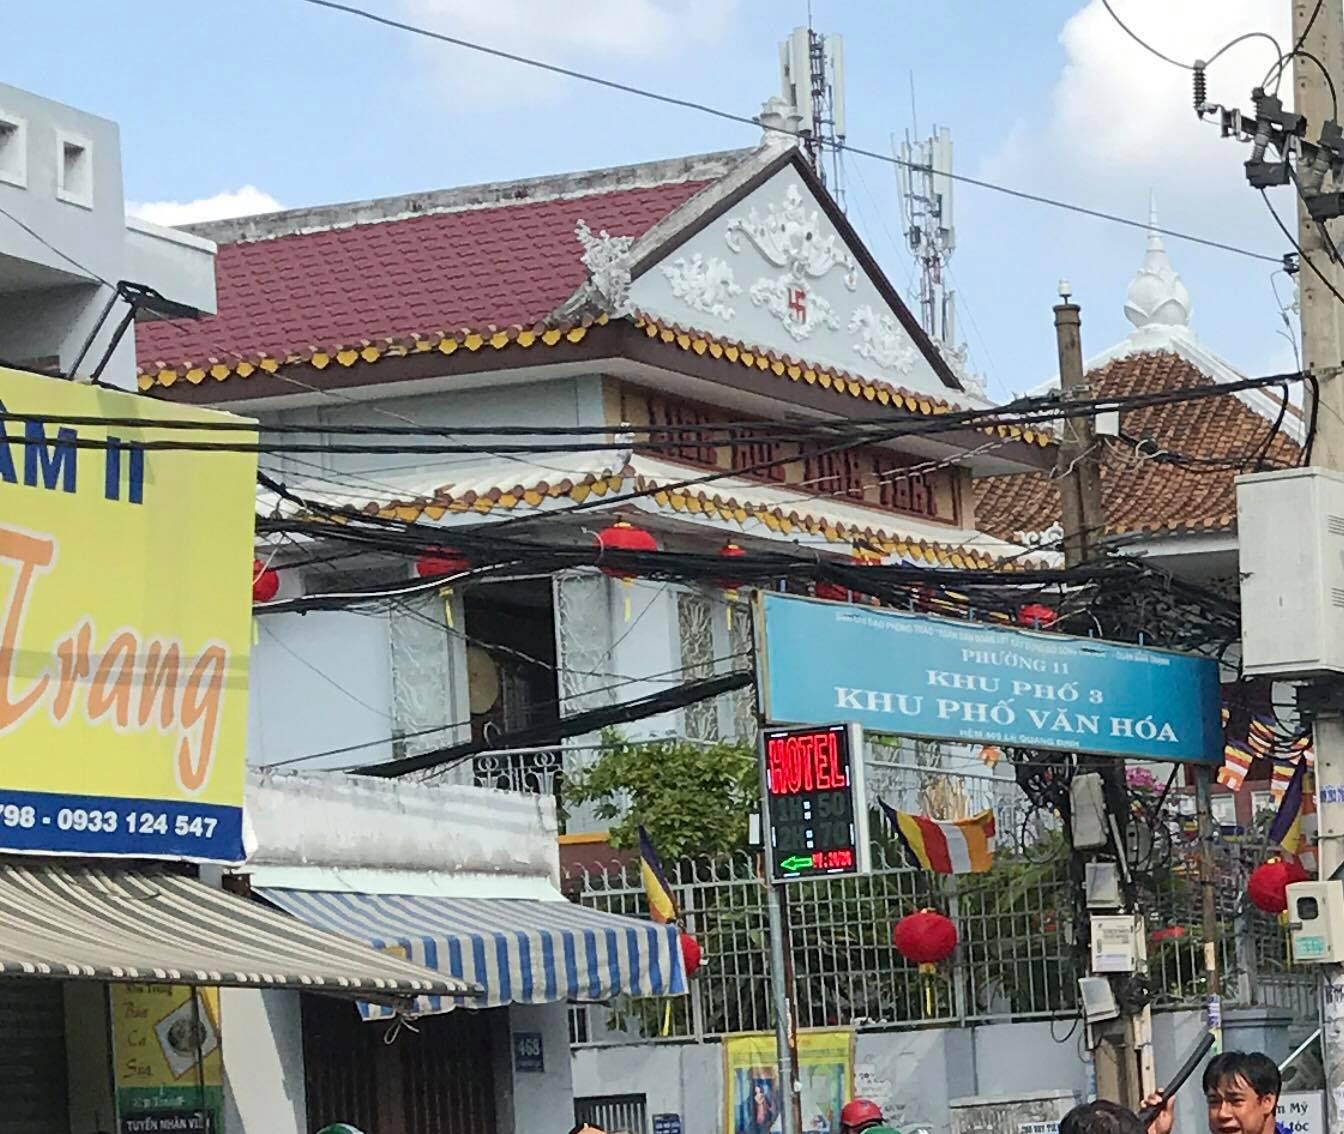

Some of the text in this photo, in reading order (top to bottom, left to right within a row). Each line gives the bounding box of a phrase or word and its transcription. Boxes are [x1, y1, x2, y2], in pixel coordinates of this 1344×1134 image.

[962, 648, 1069, 675] PHƯỜNG 11
[927, 669, 1104, 704] KHU PHỐ 3
[834, 687, 1179, 743] KHU PHỐ VĂN HÓA
[768, 733, 845, 795] HOTEL
[0, 804, 36, 828] 98
[57, 808, 118, 832] 0933
[126, 812, 168, 835] 124
[175, 815, 218, 838] 547
